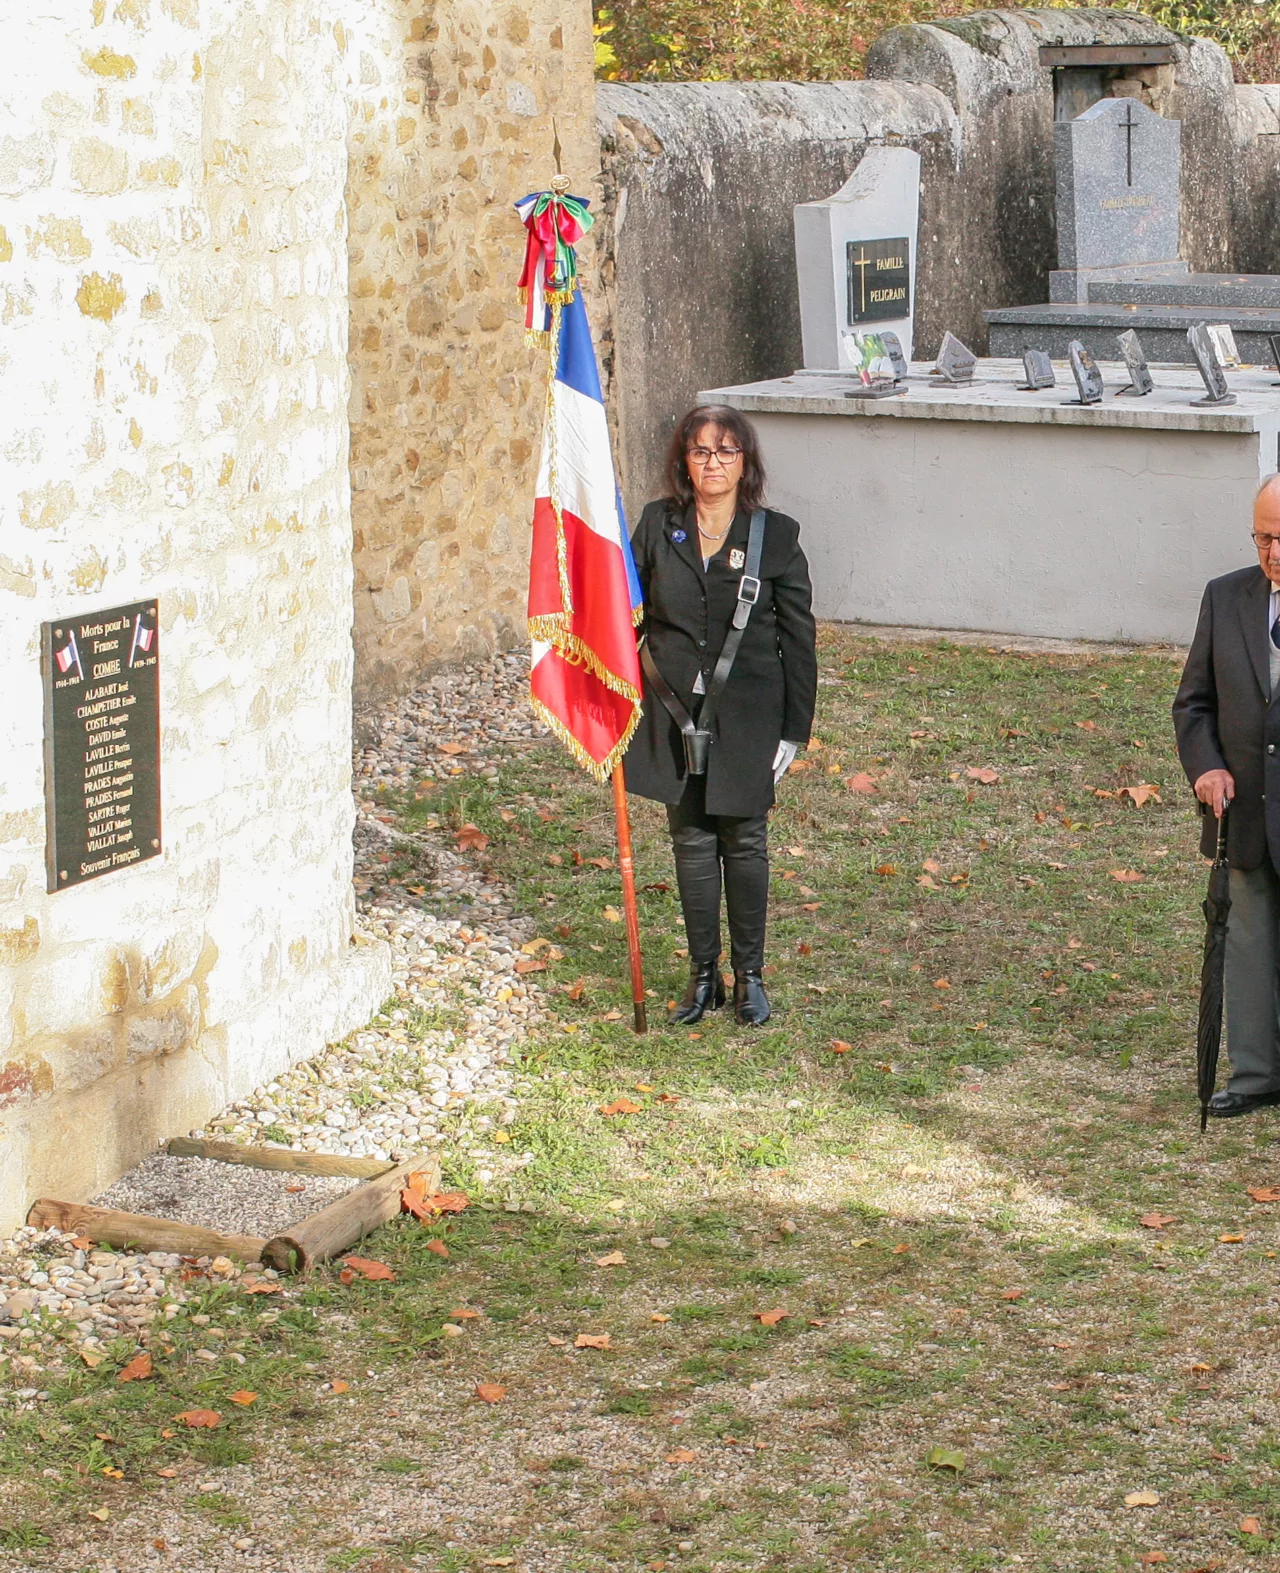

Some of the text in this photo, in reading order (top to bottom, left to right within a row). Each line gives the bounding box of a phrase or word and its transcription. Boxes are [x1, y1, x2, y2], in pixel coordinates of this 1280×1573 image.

[876, 257, 904, 271] FAMILLE
[870, 287, 906, 302] PELIGRAIN
[81, 616, 130, 638] Morts pour la
[93, 640, 119, 654] France
[93, 659, 121, 677] COMBE
[85, 683, 117, 701] ALABART
[77, 698, 121, 718] CHAMPETIER
[86, 716, 108, 732] COSTE
[89, 730, 112, 746] DAVID
[86, 744, 114, 762] LAVILLE
[84, 760, 114, 778] LAVILLE
[84, 776, 112, 794] PRADES
[86, 791, 112, 808] PRADES
[88, 806, 115, 823] SARTRE
[88, 820, 114, 838] VALLAT
[87, 834, 116, 852] VIALLAT
[81, 846, 140, 876] Souvenir Français
